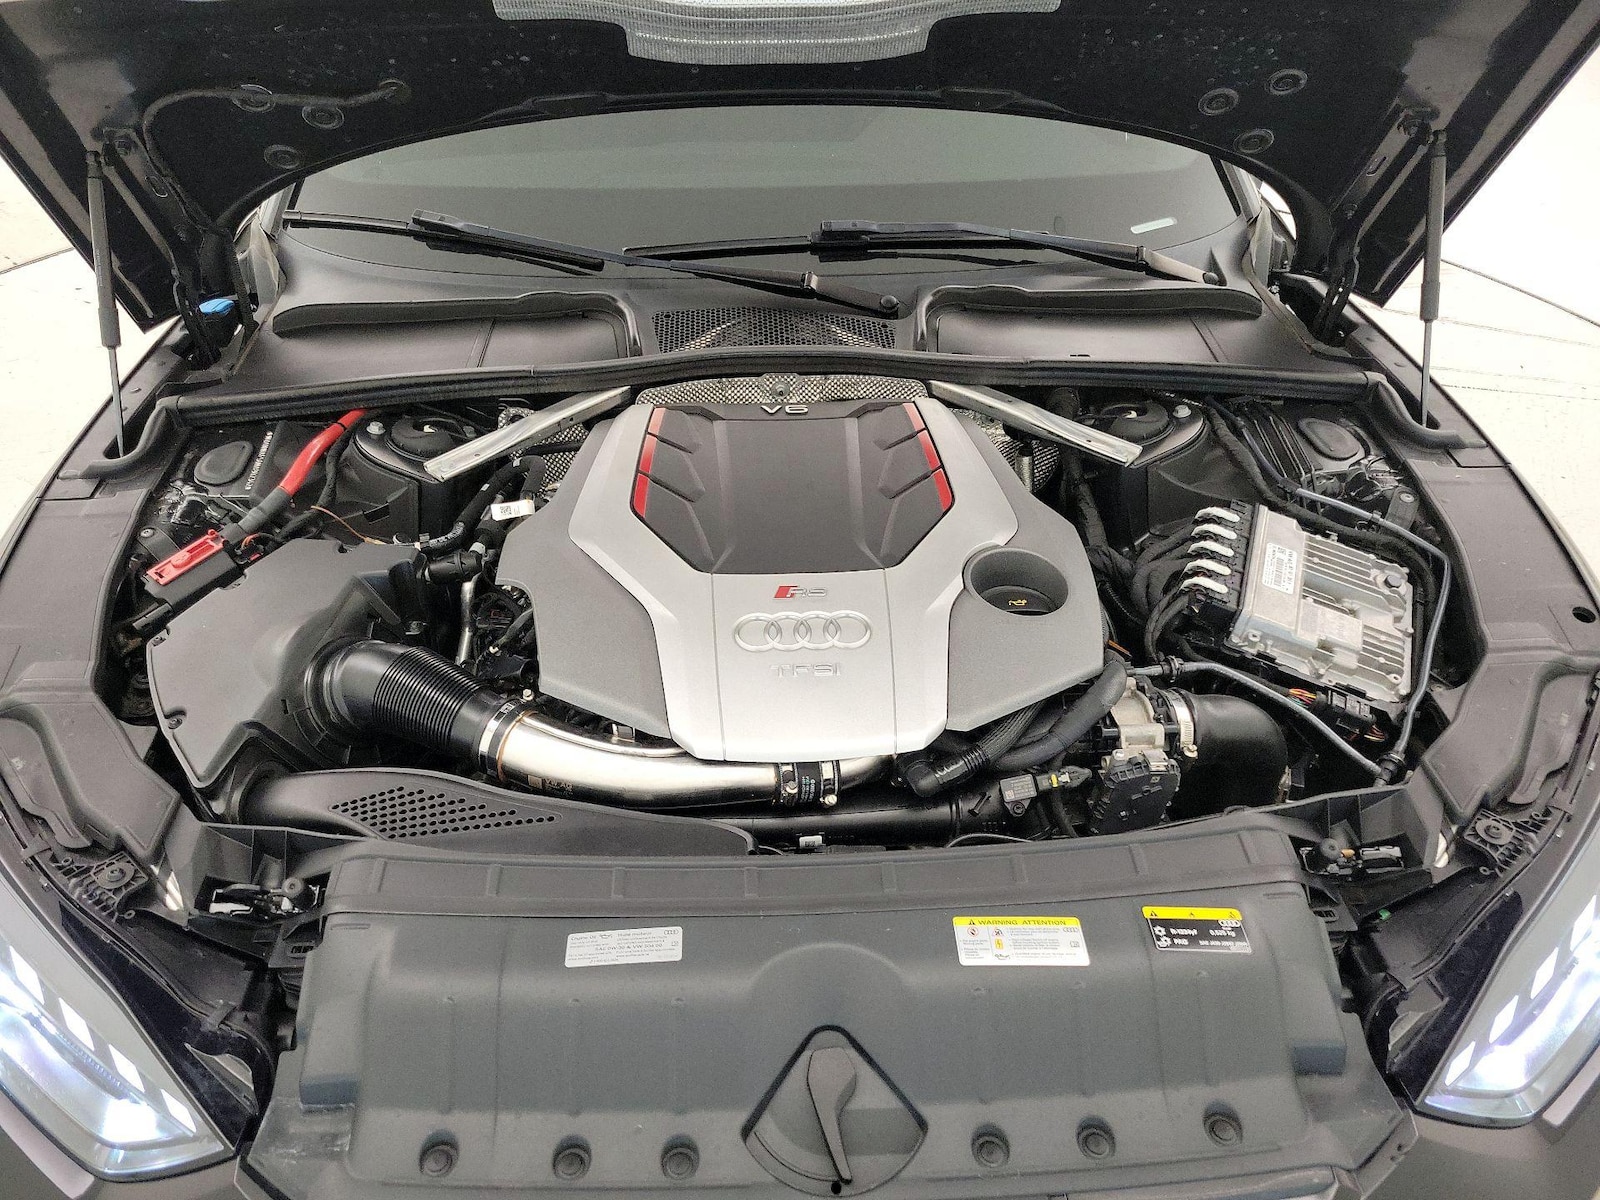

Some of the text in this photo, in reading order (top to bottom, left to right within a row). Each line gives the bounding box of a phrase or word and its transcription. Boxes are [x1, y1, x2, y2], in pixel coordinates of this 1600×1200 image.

[761, 404, 808, 415] V6
[784, 586, 828, 598] RS
[770, 663, 841, 678] TFSI
